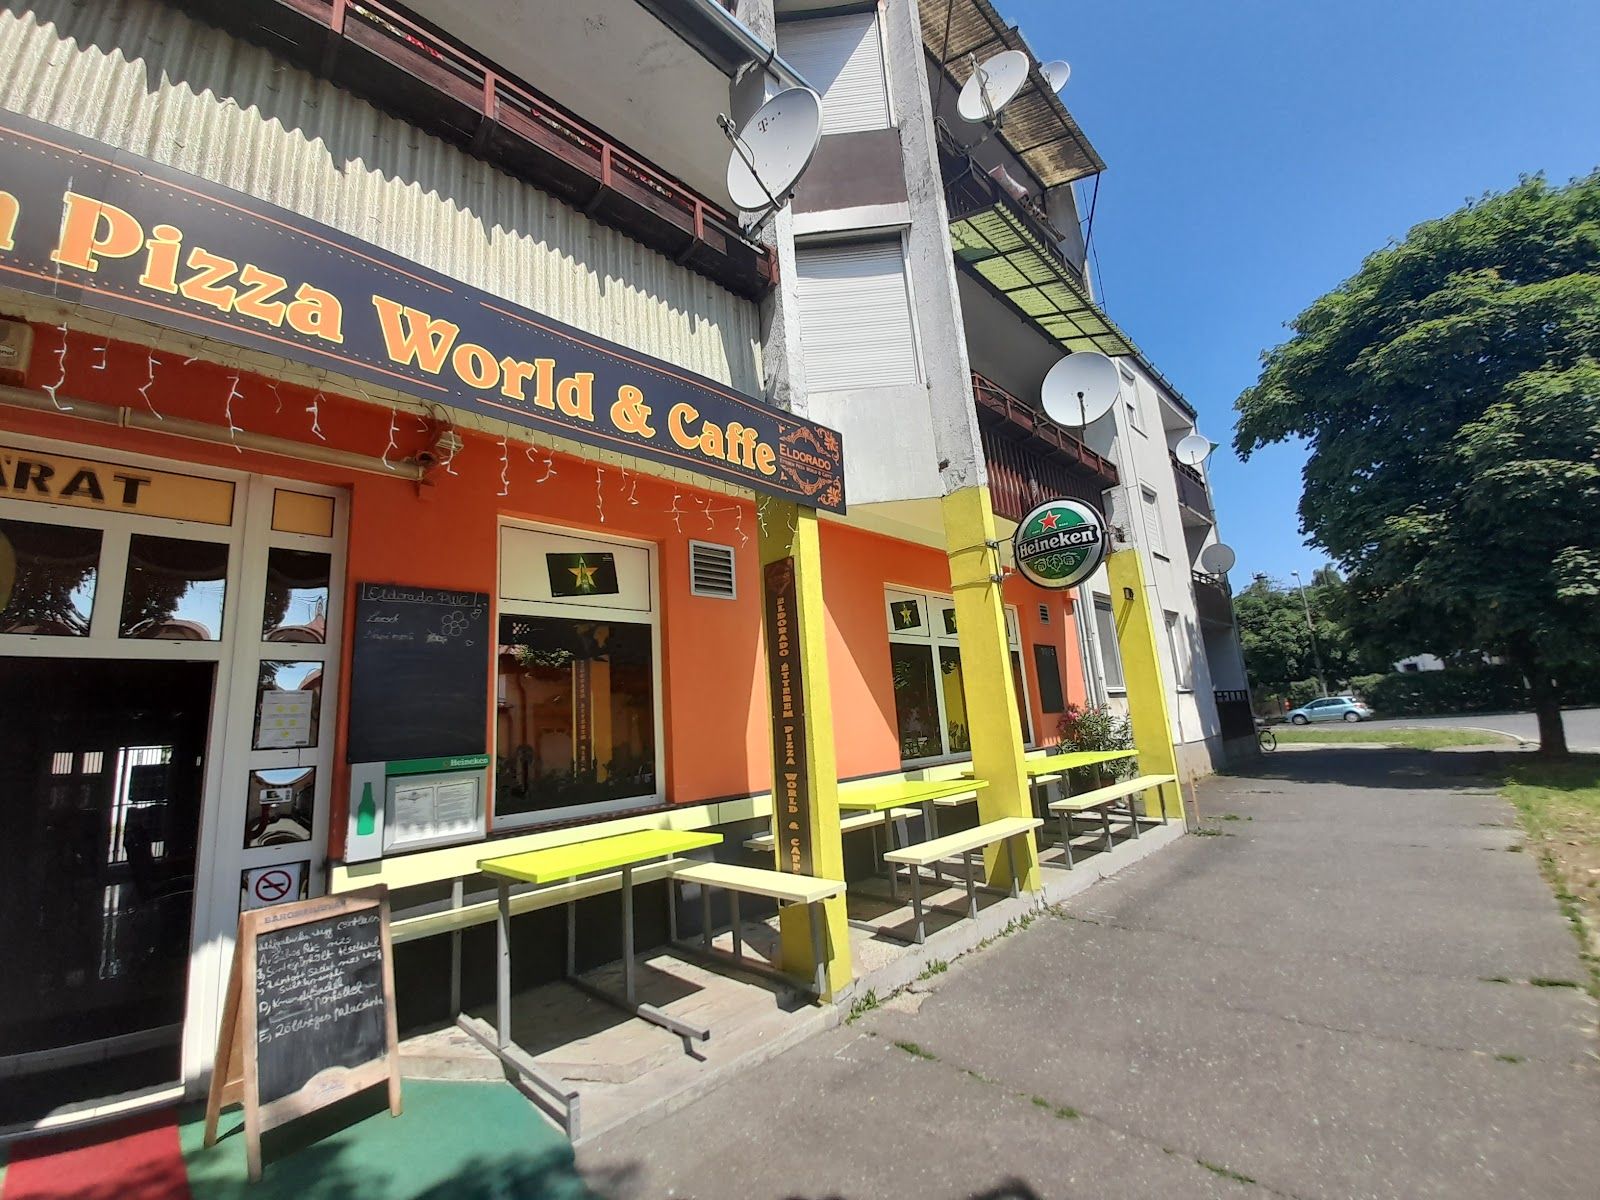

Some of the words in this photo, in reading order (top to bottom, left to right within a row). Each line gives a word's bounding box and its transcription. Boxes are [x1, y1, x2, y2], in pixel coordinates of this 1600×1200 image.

[50, 190, 344, 344] Pizza
[371, 294, 595, 423] World
[609, 383, 657, 439] &
[667, 402, 778, 477] Caffe
[779, 443, 832, 471] ELDORADO
[0, 456, 152, 507] RAT
[1019, 531, 1094, 559] Heineken
[776, 597, 790, 657] ELDORADO
[450, 757, 489, 767] Heineken
[783, 725, 796, 765] PIZZA
[784, 772, 799, 814] WORLD
[788, 821, 800, 830] &
